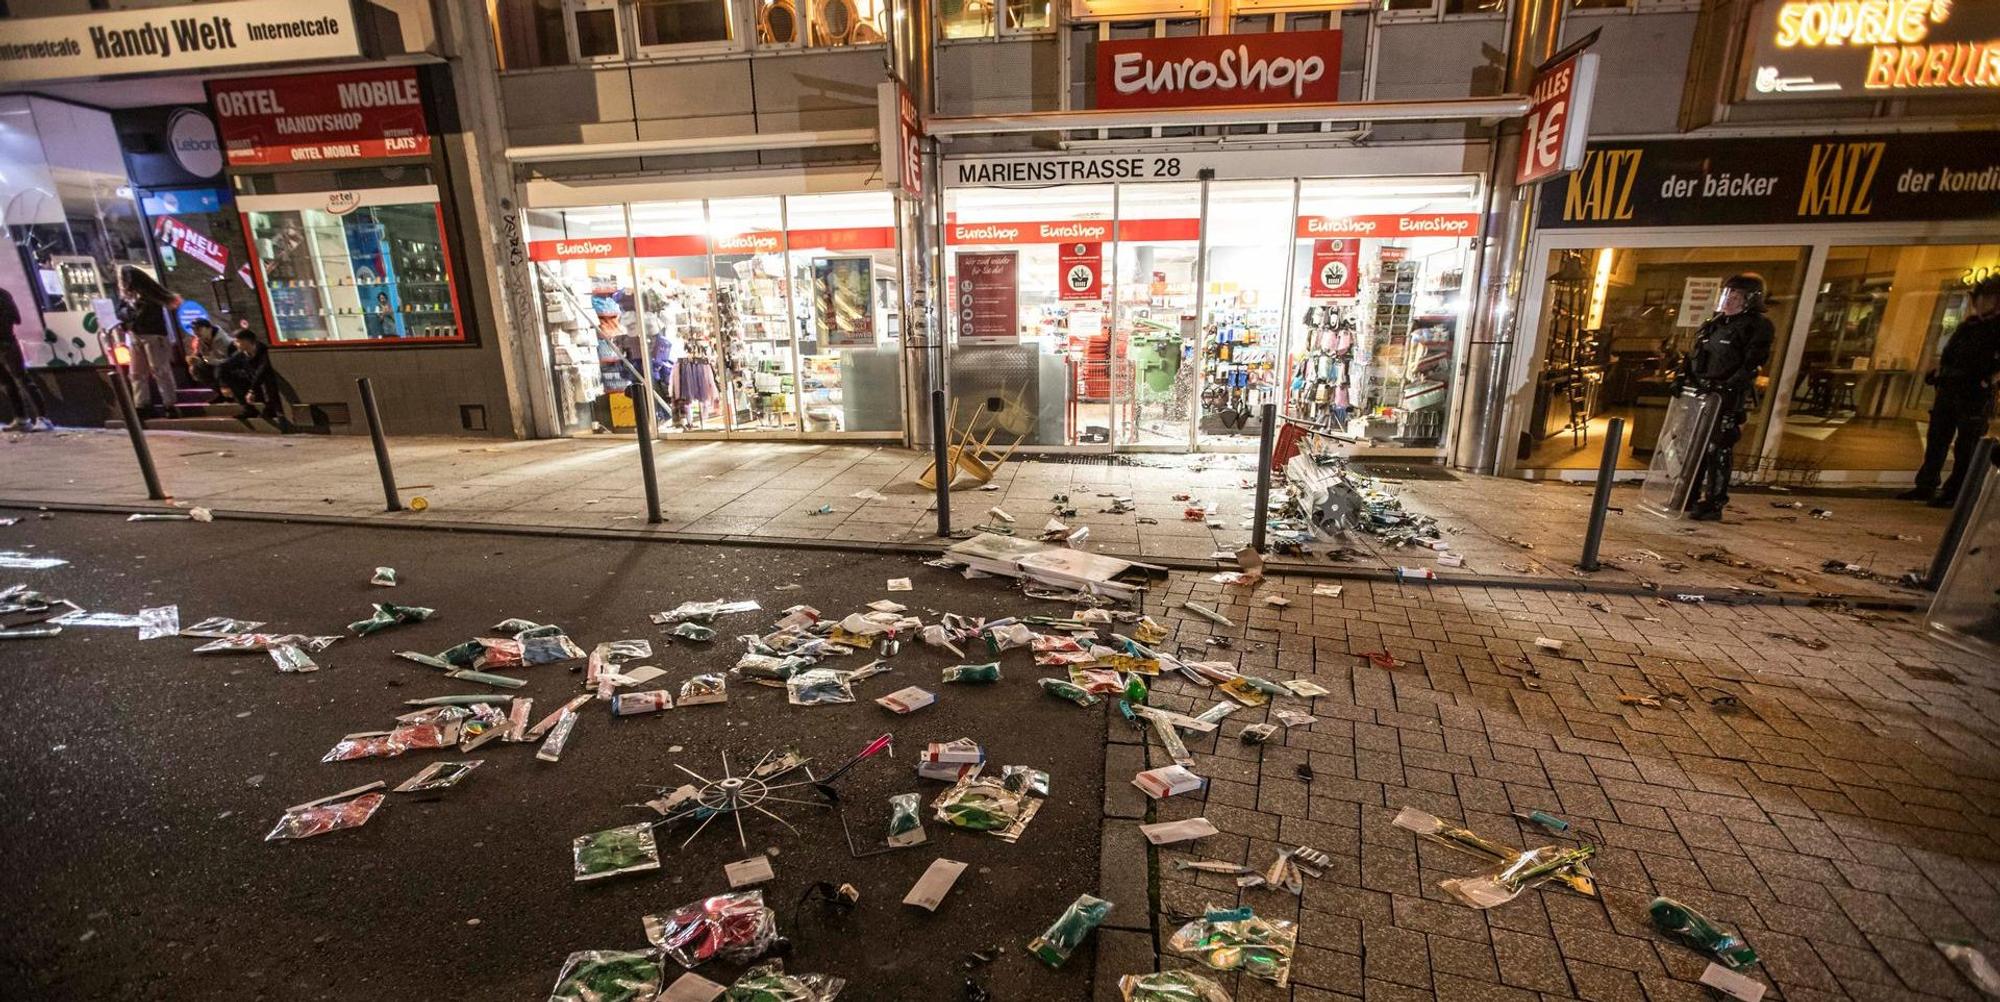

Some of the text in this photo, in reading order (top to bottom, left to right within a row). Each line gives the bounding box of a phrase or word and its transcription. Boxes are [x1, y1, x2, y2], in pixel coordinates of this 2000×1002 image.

[89, 22, 171, 59] Handy
[171, 16, 237, 52] Welt
[247, 16, 339, 41] Internetcafe
[217, 79, 420, 117] ORTEL MOBILE
[1532, 67, 1570, 105] ALLES
[275, 112, 363, 135] HANDYSHOP
[1524, 101, 1565, 176] 1€
[290, 143, 361, 161] ORTEL MOBILE
[384, 136, 416, 150] FLATS
[902, 123, 921, 192] 1€
[958, 158, 1181, 183] MARIENSTRASSE 28
[1563, 142, 2000, 221] KATZ der bäcker KATZ der kondi
[185, 228, 224, 256] NEU-
